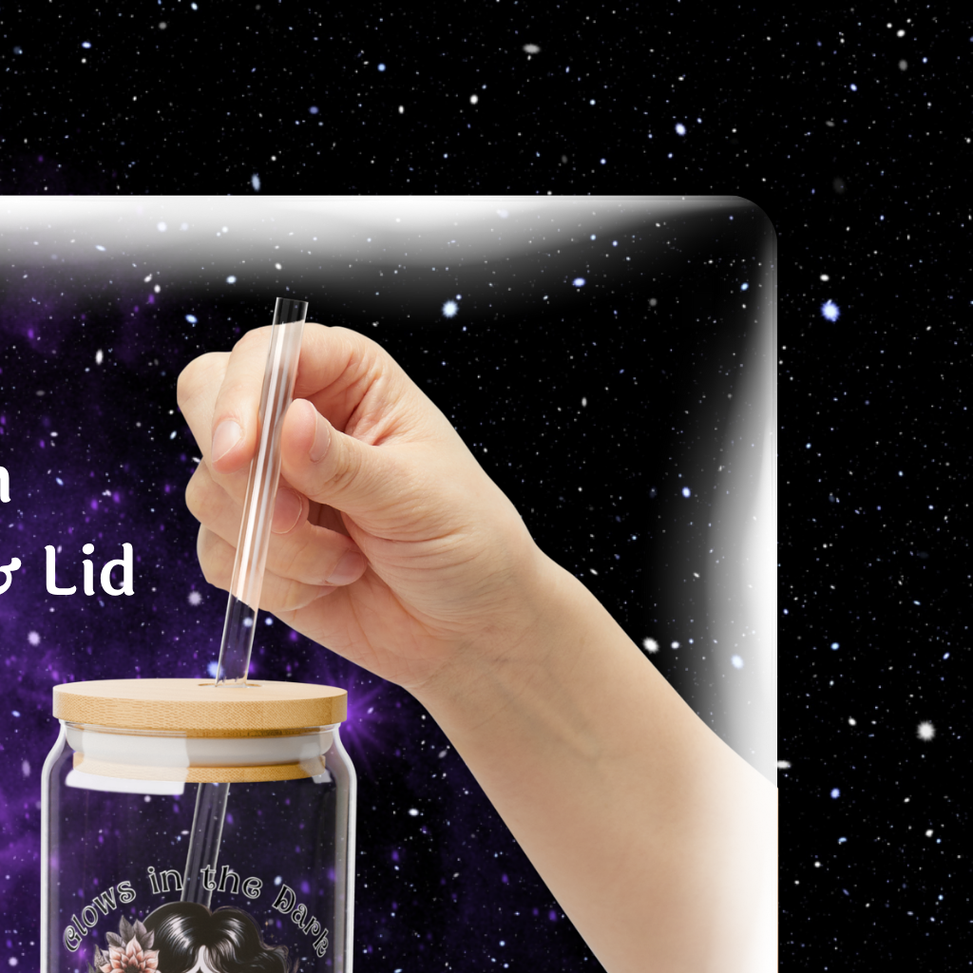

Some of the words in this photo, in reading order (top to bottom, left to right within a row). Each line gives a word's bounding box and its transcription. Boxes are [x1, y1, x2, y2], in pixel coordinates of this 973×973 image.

[63, 880, 137, 952] Glows
[147, 866, 184, 894] in
[200, 865, 264, 899] the
[272, 884, 330, 958] Dark
